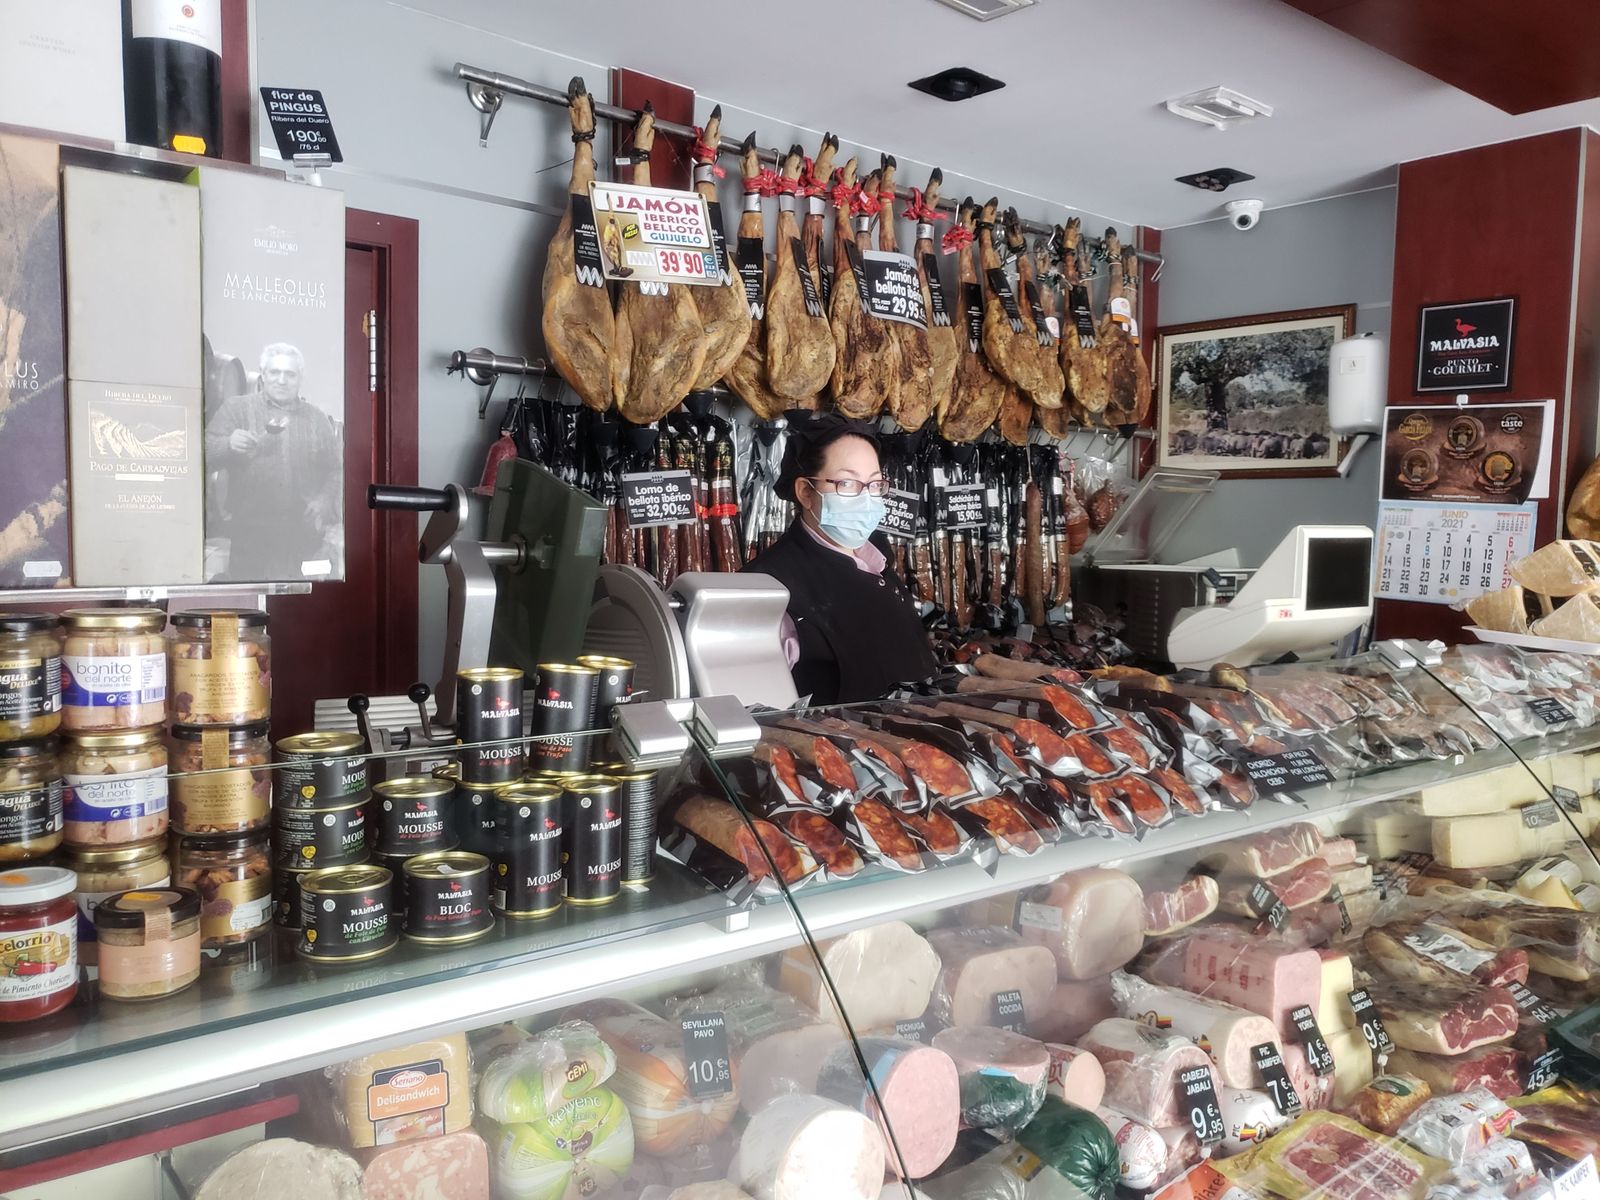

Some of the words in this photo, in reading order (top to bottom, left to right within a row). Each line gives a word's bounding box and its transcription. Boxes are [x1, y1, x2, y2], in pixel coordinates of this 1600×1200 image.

[271, 90, 294, 100] flor
[297, 92, 314, 101] de
[270, 102, 323, 113] PINGUS
[271, 115, 295, 123] Ribera
[615, 195, 700, 217] JAMÓN
[644, 213, 699, 226] IBERICO
[643, 222, 704, 236] BELLOTA
[650, 232, 702, 244] GUIJUELO
[884, 267, 912, 285] Jamón
[225, 271, 325, 298] MALLEOLUS
[875, 279, 906, 297] bellota
[223, 288, 237, 299] DE
[892, 296, 919, 320] 29,95
[1430, 335, 1500, 352] MALVASIA
[1447, 358, 1479, 367] PUNTO
[1433, 363, 1493, 376] GOURMET
[0, 379, 39, 391] MIRO
[1501, 420, 1524, 428] taste
[90, 461, 114, 472] PAGO
[116, 464, 128, 472] DE
[634, 485, 664, 495] Lomo
[665, 482, 679, 492] de
[118, 494, 129, 503] EL
[131, 493, 162, 504] ANEJÓN
[628, 494, 660, 506] bellota
[661, 492, 692, 503] ibérico
[646, 502, 677, 518] 32,90
[898, 501, 909, 510] de
[891, 506, 914, 520] ibérico
[956, 510, 976, 523] 15,90
[1441, 510, 1469, 519] JUNIO
[1441, 518, 1464, 529] 2021
[1408, 530, 1412, 541] 1
[1426, 532, 1431, 543] 2
[1446, 533, 1451, 544] 3
[1466, 534, 1472, 545] 4
[1487, 535, 1493, 546] 5
[1508, 536, 1514, 548] 6
[1387, 542, 1392, 553] 7
[1405, 543, 1411, 554] 8
[1425, 544, 1430, 556] 9
[1443, 546, 1452, 557] 10
[1464, 547, 1472, 559] 11
[1484, 549, 1494, 560] 12
[1384, 555, 1392, 567] 14
[1403, 556, 1412, 568] 15
[1422, 558, 1431, 569] 16
[1442, 559, 1451, 570] 17
[1462, 561, 1471, 572] 18
[1482, 562, 1492, 574] 19
[1382, 568, 1392, 579] 21
[1401, 569, 1411, 581] 22
[1419, 571, 1430, 583] 23
[1440, 573, 1450, 584] 24
[1459, 574, 1470, 586] 25
[1480, 576, 1491, 588] 26
[1501, 577, 1512, 589] 27
[1380, 581, 1390, 592] 28
[1399, 582, 1409, 594] 29
[1418, 584, 1429, 595] 30
[76, 661, 132, 675] bonito
[84, 674, 101, 683] del
[103, 675, 132, 683] norte
[481, 707, 520, 719] MALVASIA
[479, 746, 522, 760] MOUSSE
[1266, 776, 1287, 787] CEBO
[88, 789, 104, 799] del
[404, 809, 439, 819] MALVASIA
[397, 821, 444, 834] MOUSSE
[437, 889, 473, 900] MALVASIA
[350, 902, 385, 916] MALVASIA
[439, 902, 472, 916] BLOC
[342, 913, 388, 934] MOUSSE
[11, 982, 42, 994] Pimiento
[997, 991, 1021, 1004] PALETA
[998, 1003, 1023, 1015] COCIDA
[682, 1017, 725, 1030] SEVILLANA
[896, 1021, 926, 1032] PECHUGA
[1297, 1018, 1315, 1032] YORK
[693, 1029, 715, 1039] PAVO
[902, 1031, 921, 1041] PAVO
[1181, 1067, 1210, 1083] CABEZA
[1186, 1079, 1212, 1096] JABALI
[376, 1084, 440, 1108] Delisandwich
